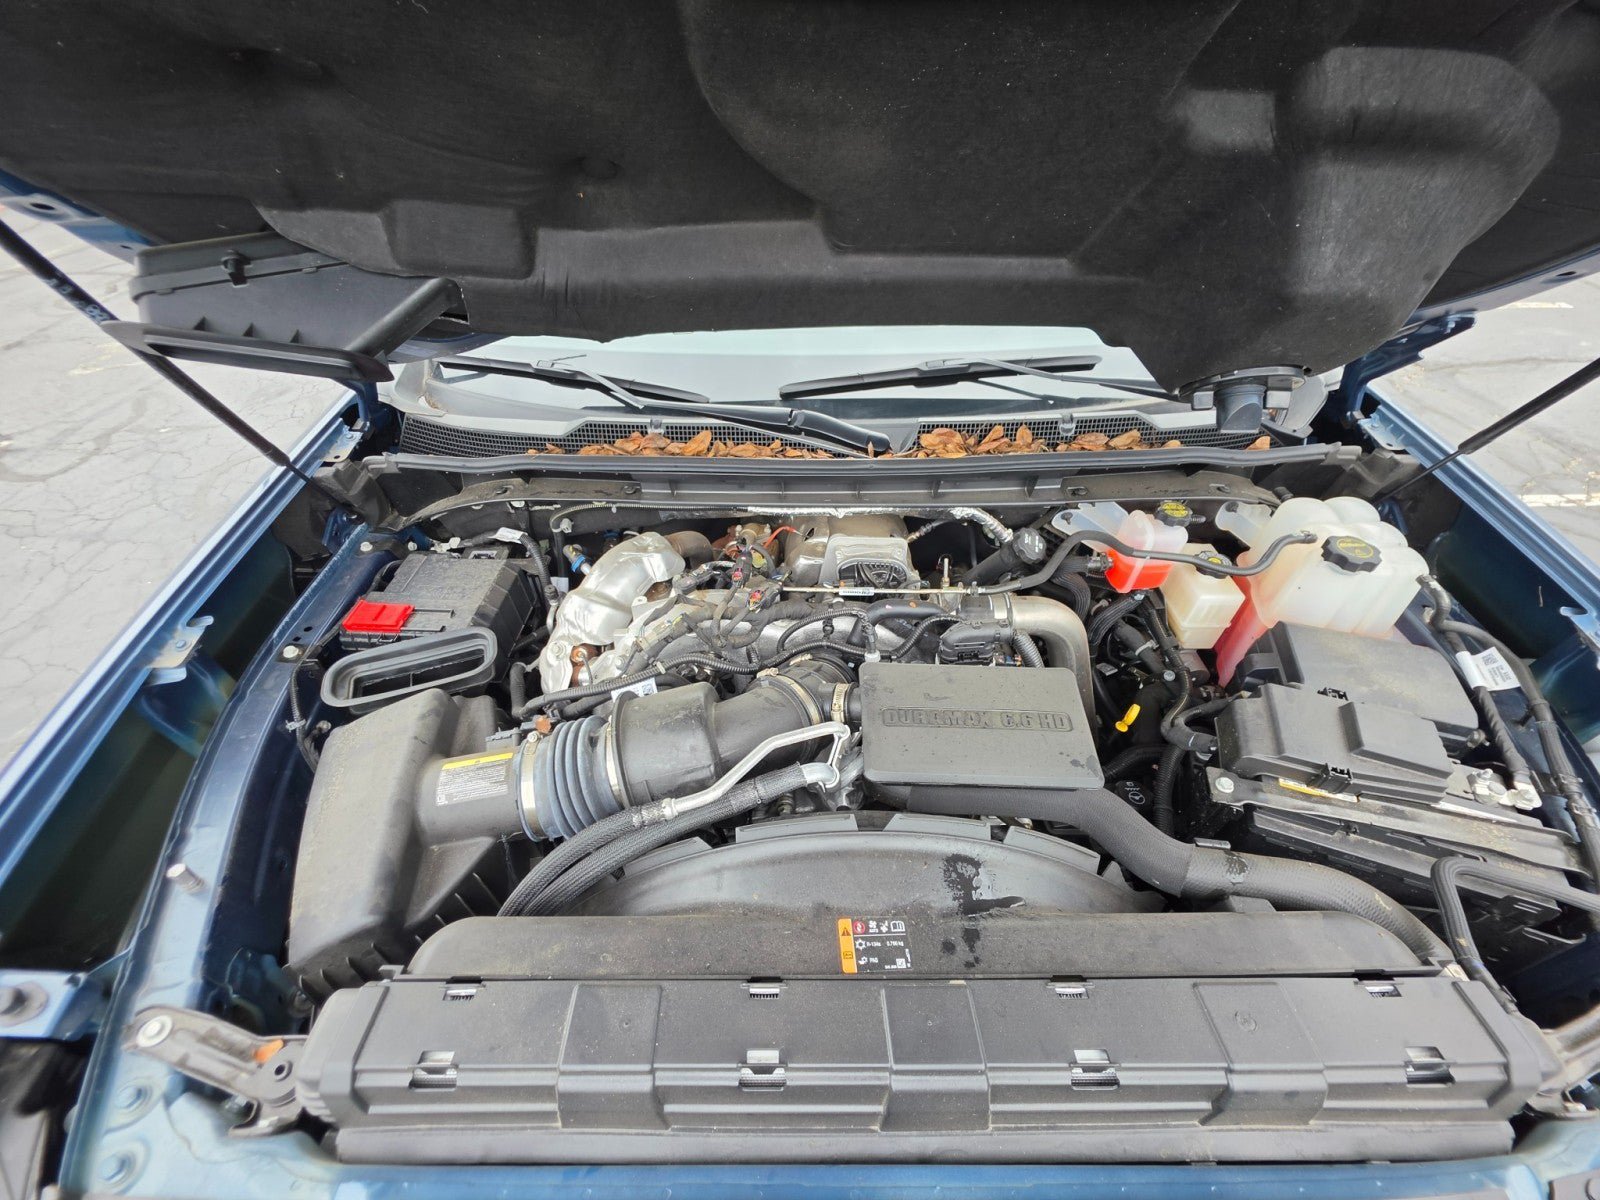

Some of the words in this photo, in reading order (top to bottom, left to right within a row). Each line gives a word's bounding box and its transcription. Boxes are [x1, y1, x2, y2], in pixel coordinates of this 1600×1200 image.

[884, 710, 993, 728] DURAMAX
[1001, 712, 1034, 728] 6.6
[1040, 713, 1072, 731] HD
